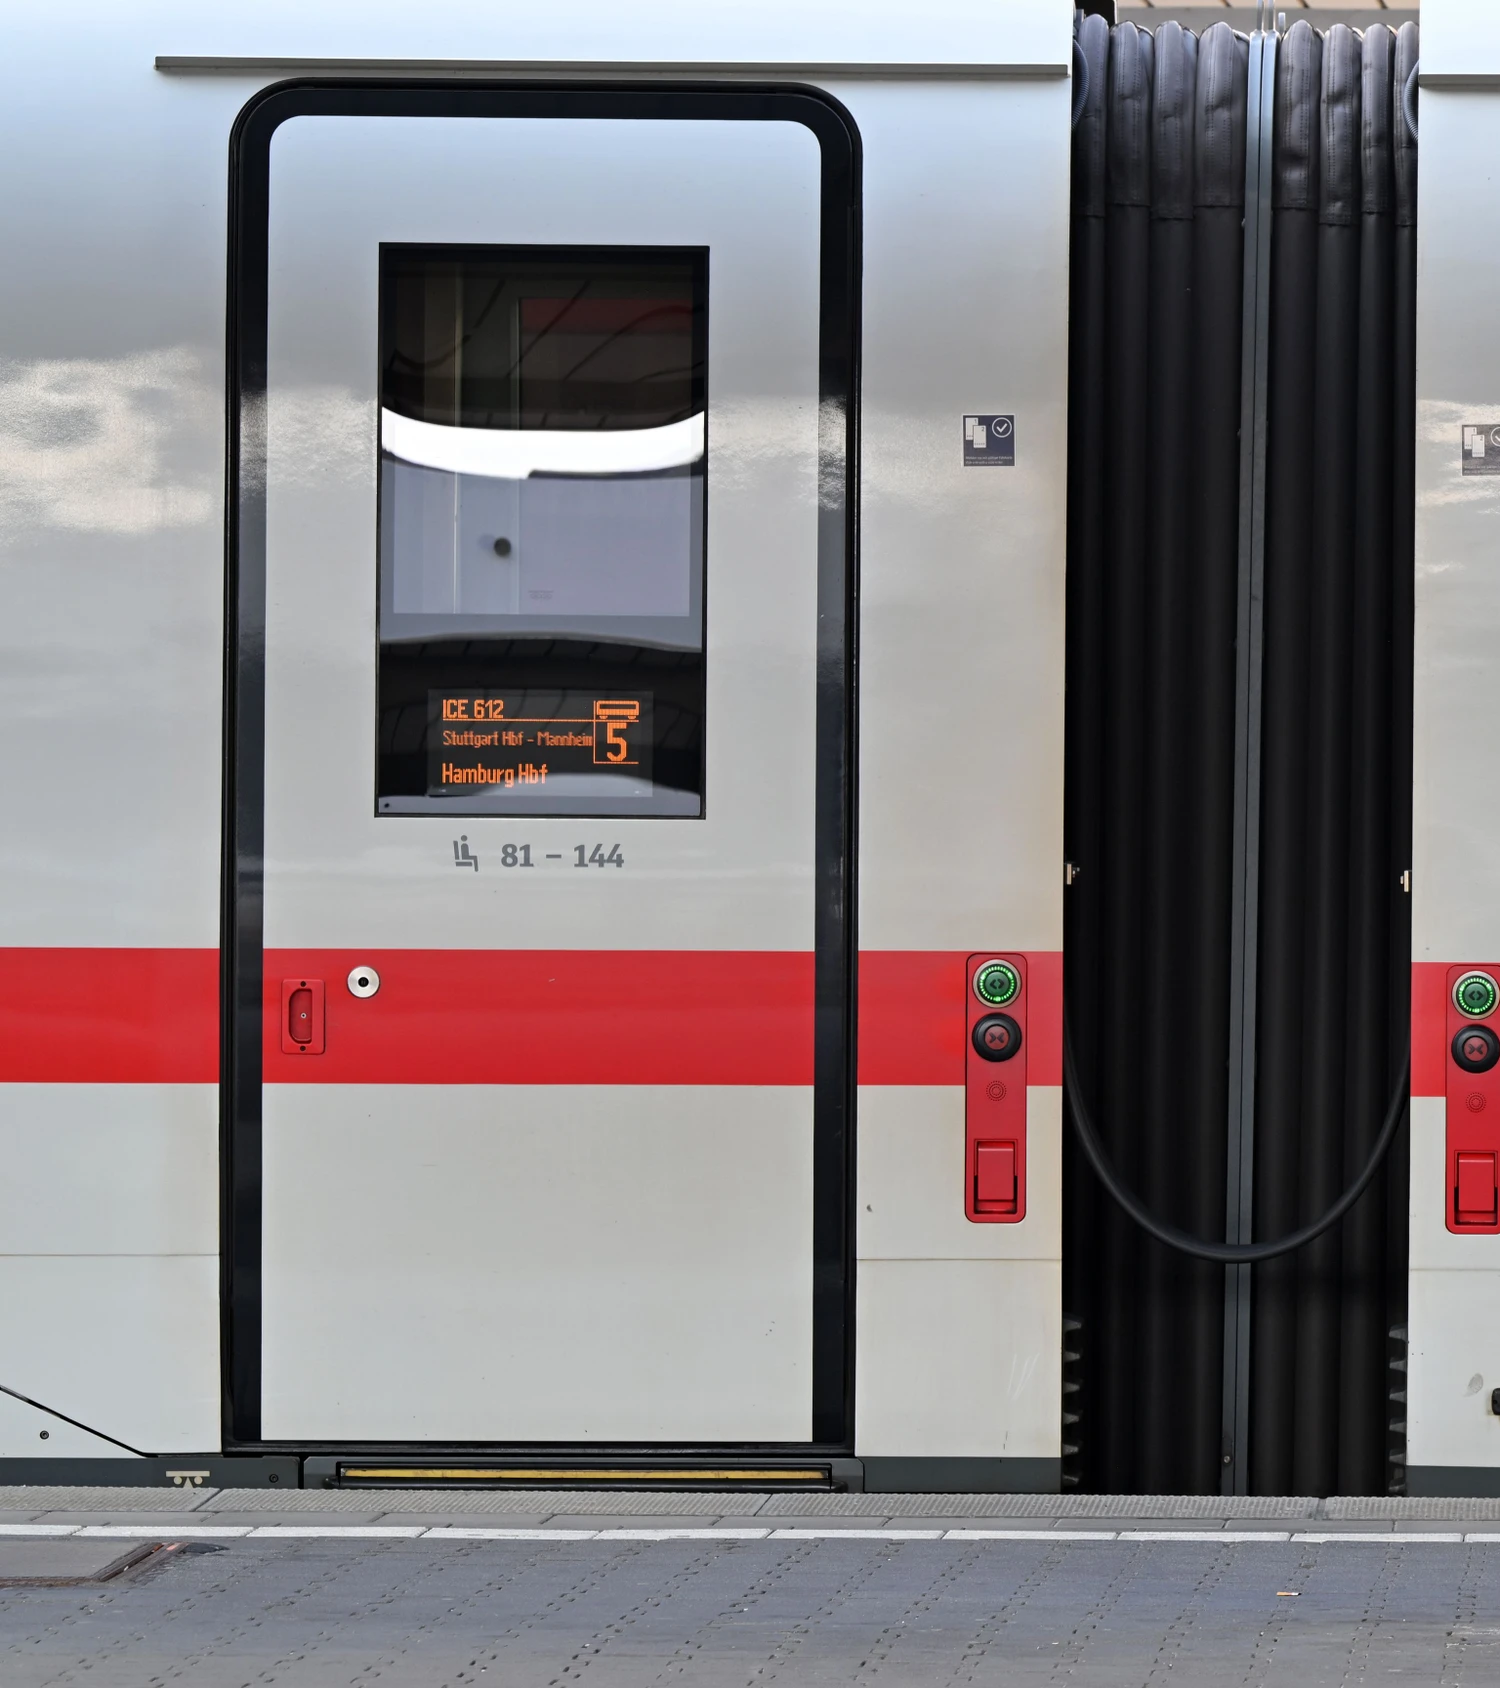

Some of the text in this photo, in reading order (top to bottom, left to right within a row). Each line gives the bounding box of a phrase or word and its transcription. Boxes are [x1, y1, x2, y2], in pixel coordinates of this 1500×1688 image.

[442, 699, 504, 719] ICE 612
[442, 730, 499, 748] Stuttgart
[502, 731, 524, 746] Hbf
[537, 731, 593, 747] Mannheim
[606, 722, 628, 762] 5
[441, 763, 549, 788] Hamburg Hbf
[500, 843, 534, 868] 81
[573, 843, 625, 868] 144
